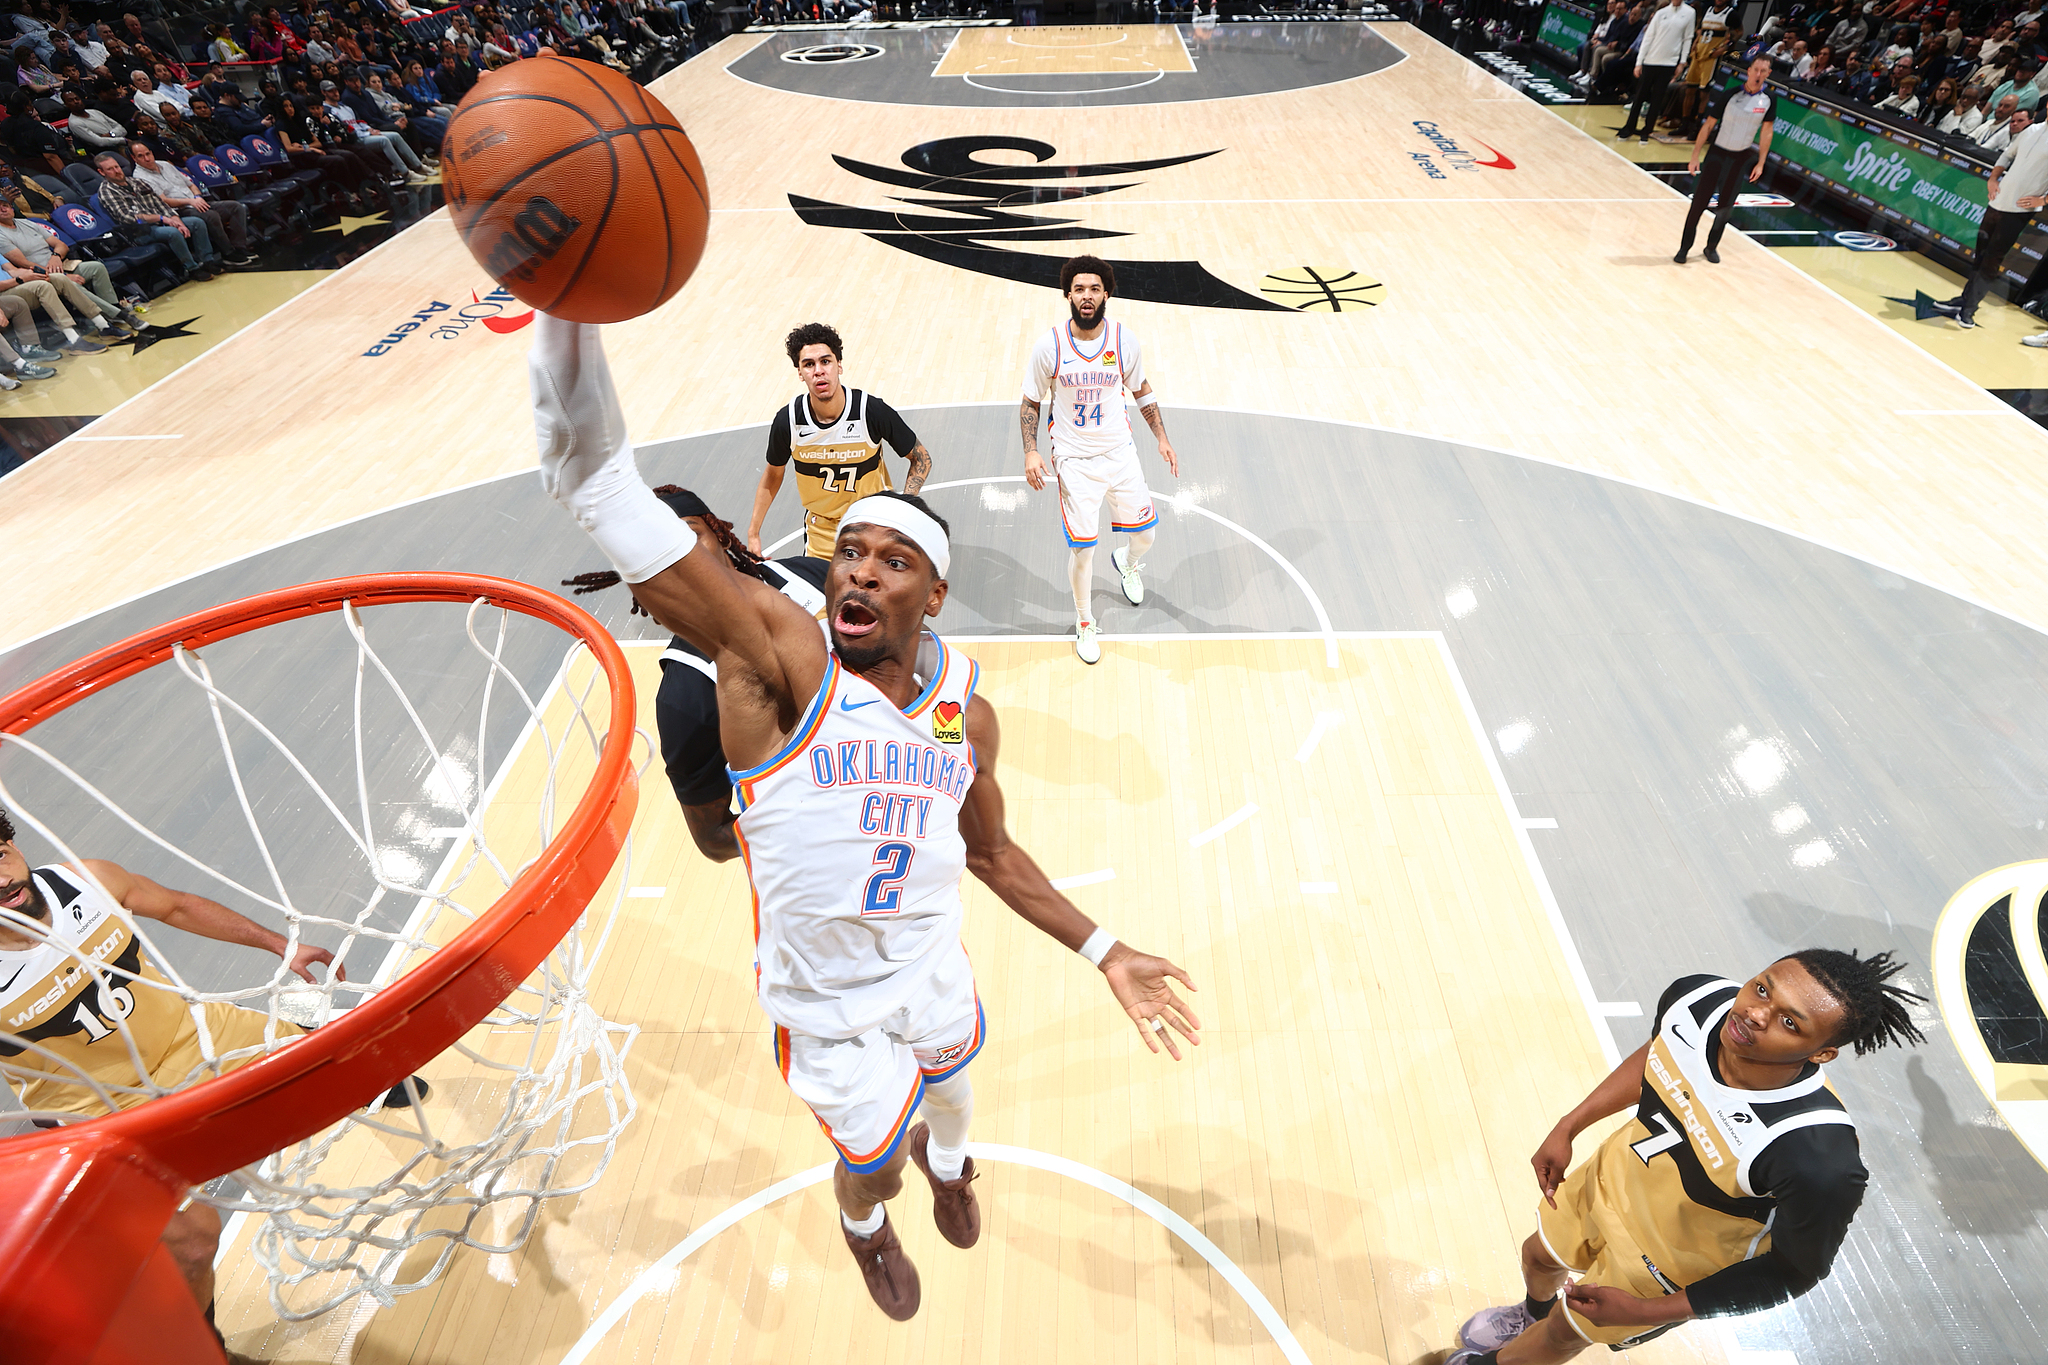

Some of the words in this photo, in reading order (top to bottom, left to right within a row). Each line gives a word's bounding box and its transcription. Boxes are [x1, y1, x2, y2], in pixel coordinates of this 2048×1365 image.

[1701, 30, 1714, 44] 13
[1474, 51, 1535, 78] Hidden
[1520, 78, 1586, 102] Level
[1412, 121, 1470, 153] Capital
[1442, 151, 1480, 172] One
[1786, 124, 1811, 144] YOUR
[1806, 133, 1839, 156] THIRST
[1407, 151, 1447, 179] Arena
[1843, 141, 1912, 192] Sprite
[1911, 179, 1944, 203] OBEY
[1936, 190, 1971, 216] YOUR
[484, 196, 582, 290] Wils
[361, 300, 452, 357] Arena
[429, 302, 503, 340] One
[1058, 370, 1121, 388] OKLAHOMA
[1076, 388, 1102, 403] CITY
[1073, 403, 1104, 428] 34
[799, 448, 866, 462] washington
[819, 466, 858, 493] 27
[809, 740, 969, 804] OKLAHOMA
[859, 791, 933, 839] CITY
[861, 840, 916, 916] 2
[77, 911, 102, 936] Robinhood
[69, 972, 135, 1045] 16
[1630, 1110, 1685, 1168] 7
[1717, 1109, 1743, 1147] Robinhood
